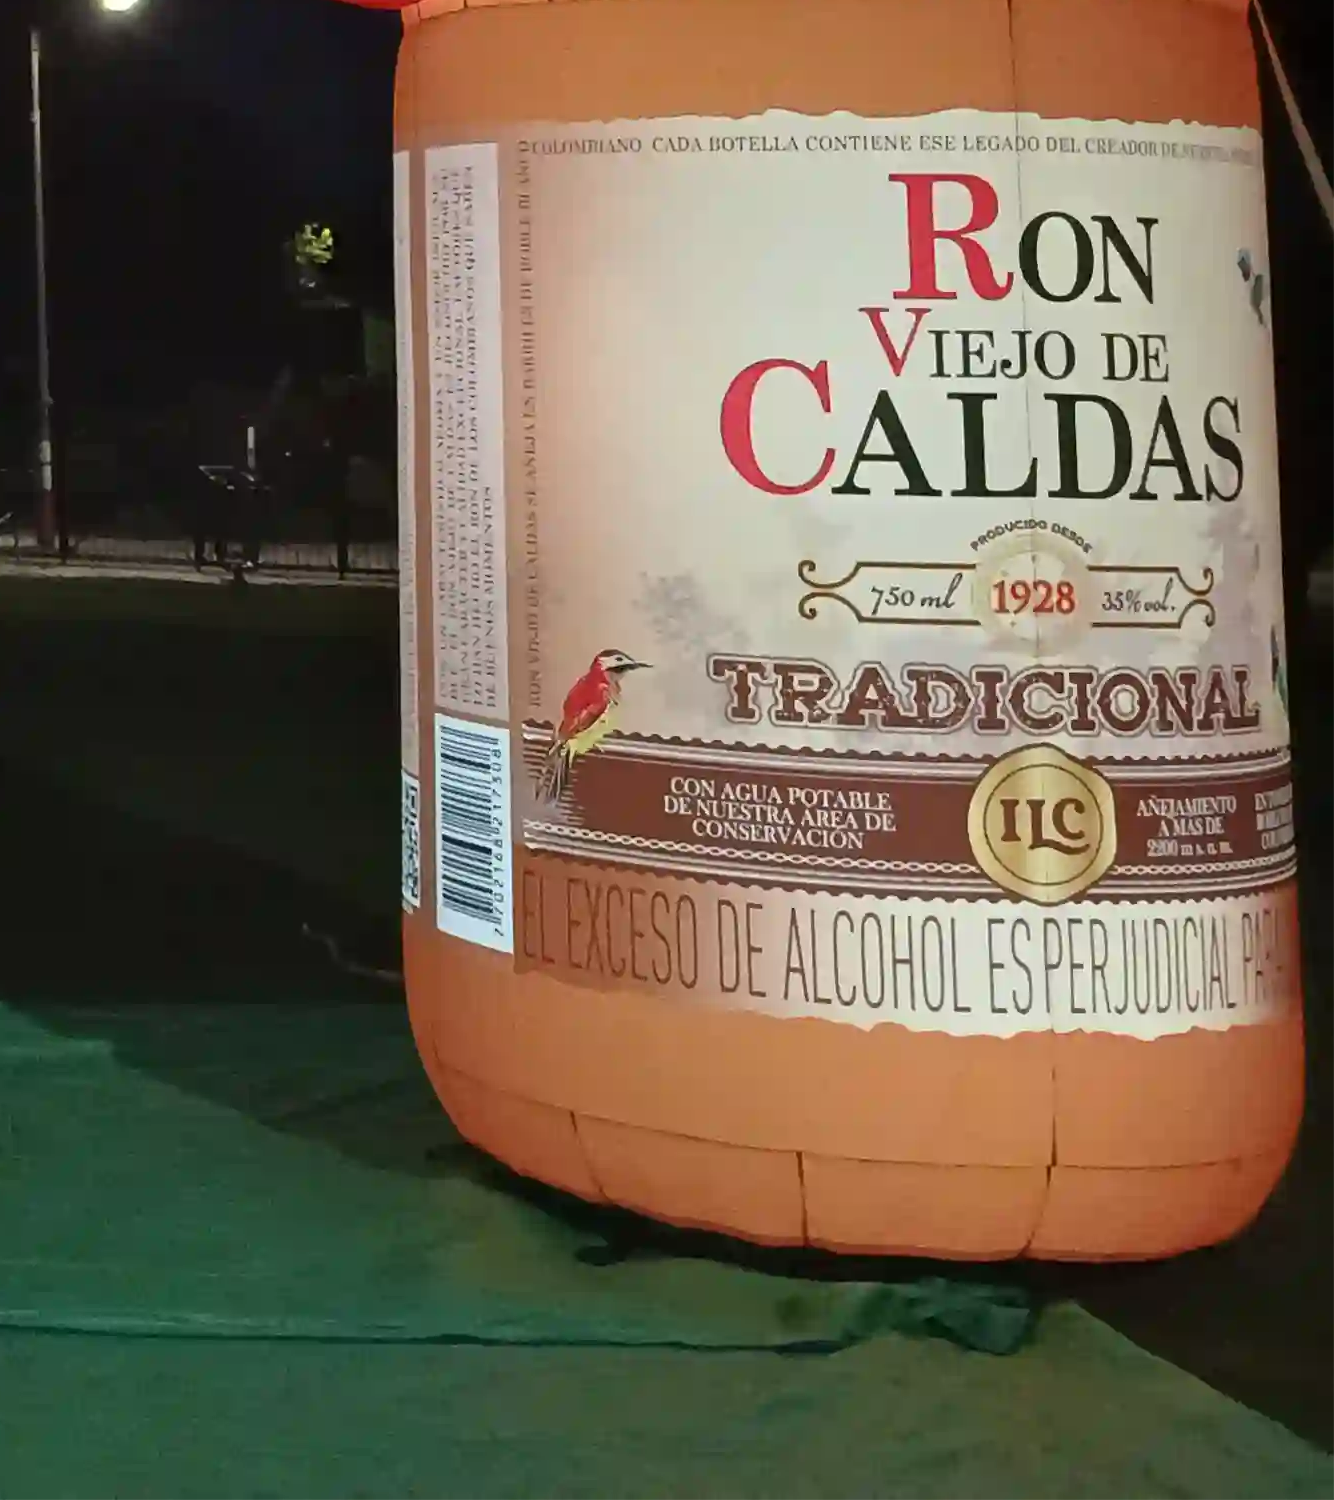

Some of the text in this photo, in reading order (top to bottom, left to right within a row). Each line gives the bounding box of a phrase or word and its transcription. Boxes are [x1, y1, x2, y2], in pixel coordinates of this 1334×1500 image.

[532, 137, 642, 155] COLOMBIANO
[652, 135, 703, 153] CADA
[709, 135, 799, 152] BOTELLA
[805, 135, 912, 152] CONTIENE
[920, 135, 956, 152] ESE
[963, 136, 1039, 152] LEGADO
[1046, 137, 1081, 153] DEL
[1085, 138, 1159, 157] CREADOR
[858, 307, 1169, 382] VIEJO DE
[720, 358, 1244, 502] CALDAS
[970, 519, 1047, 551] PRODUCIDO
[870, 572, 963, 616] 750 ml
[991, 580, 1076, 616] 1928
[709, 654, 1261, 736] TRADICIONAL
[670, 776, 892, 811] CON AGUA POTABLE
[663, 795, 692, 815] DE
[696, 799, 795, 825] NUESTRA
[864, 812, 896, 831] DE
[1000, 796, 1092, 857] ILC
[1158, 819, 1170, 837] A
[1206, 816, 1225, 835] DE
[691, 818, 865, 850] CONSERVACIÓN
[522, 870, 555, 964] EL
[567, 877, 699, 990] EXCESO
[718, 898, 767, 998] DE
[783, 907, 972, 1015] ALCOHOL
[988, 917, 1033, 1015] ES
[1042, 914, 1237, 1017] PERJUDICIAL
